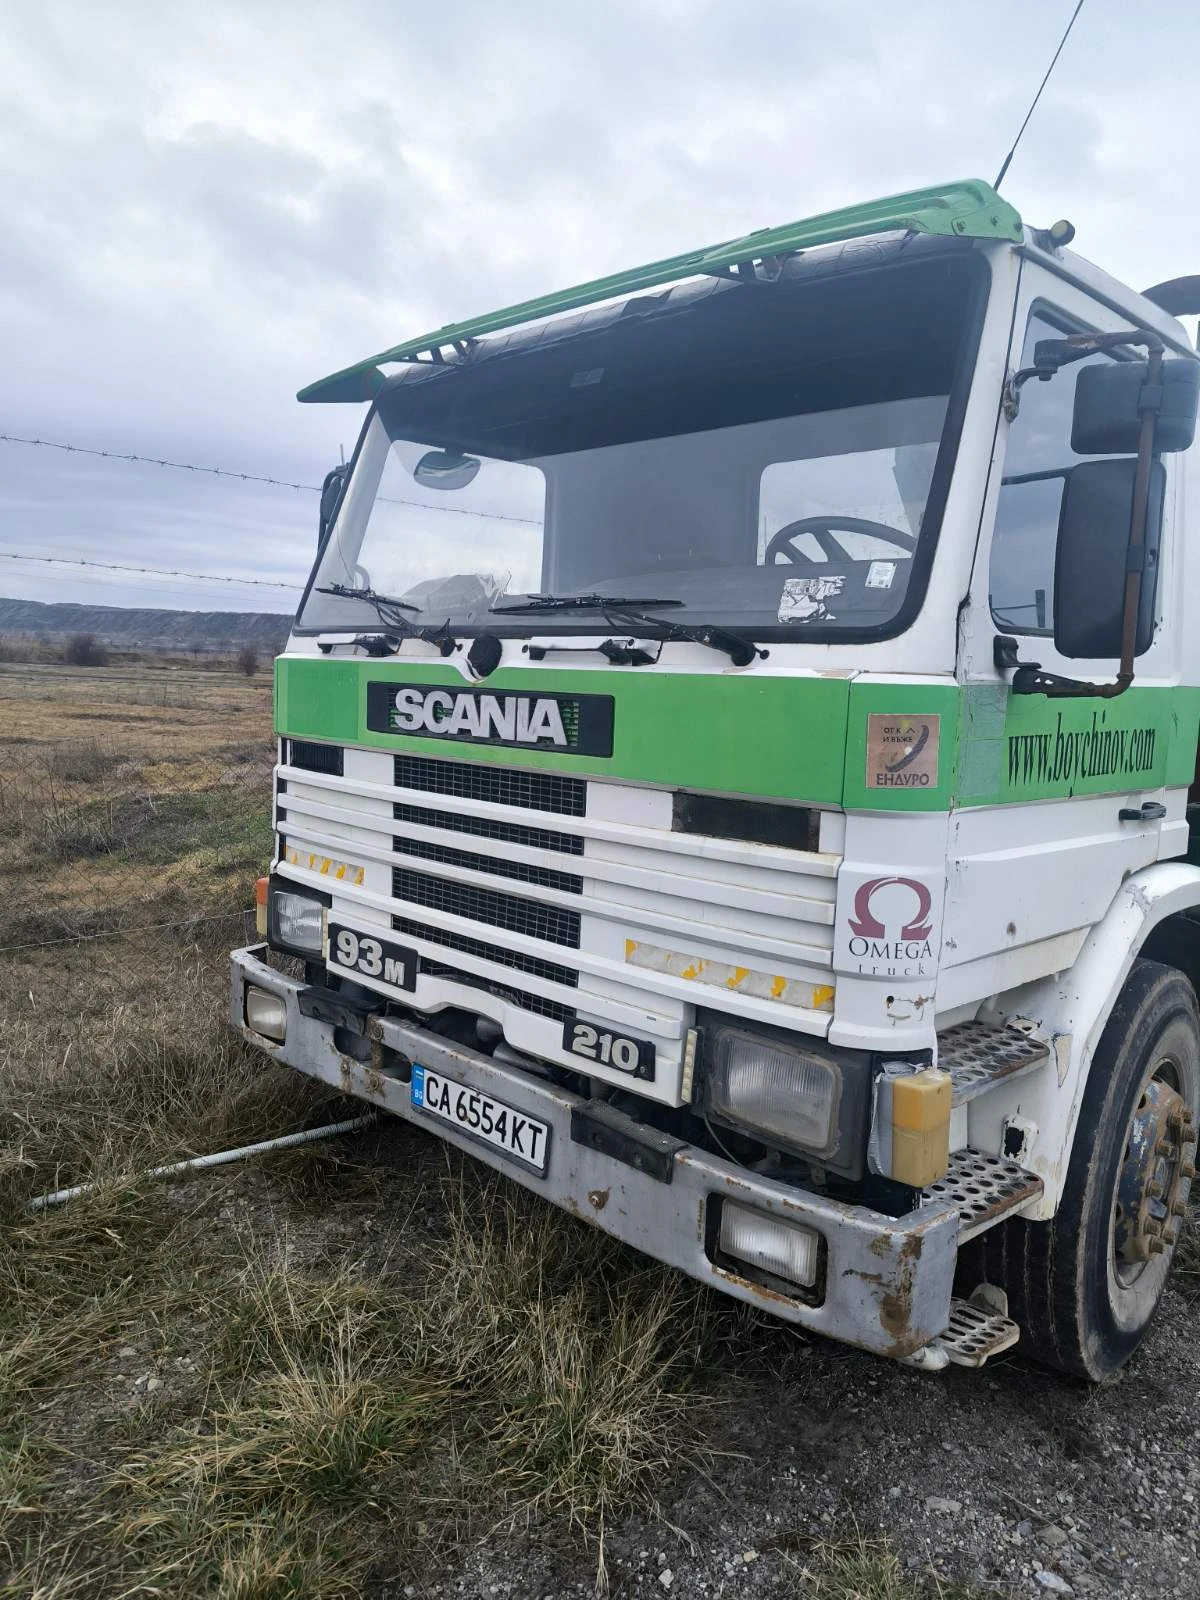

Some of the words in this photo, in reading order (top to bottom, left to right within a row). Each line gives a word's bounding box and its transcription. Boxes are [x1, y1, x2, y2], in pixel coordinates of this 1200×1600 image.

[395, 688, 568, 746] SCANIA
[1008, 709, 1156, 798] www.boychinov.com
[876, 773, 930, 786] ЕНДУРО
[848, 937, 932, 960] OMEGA
[858, 963, 926, 976] truck
[571, 1024, 639, 1071] 210
